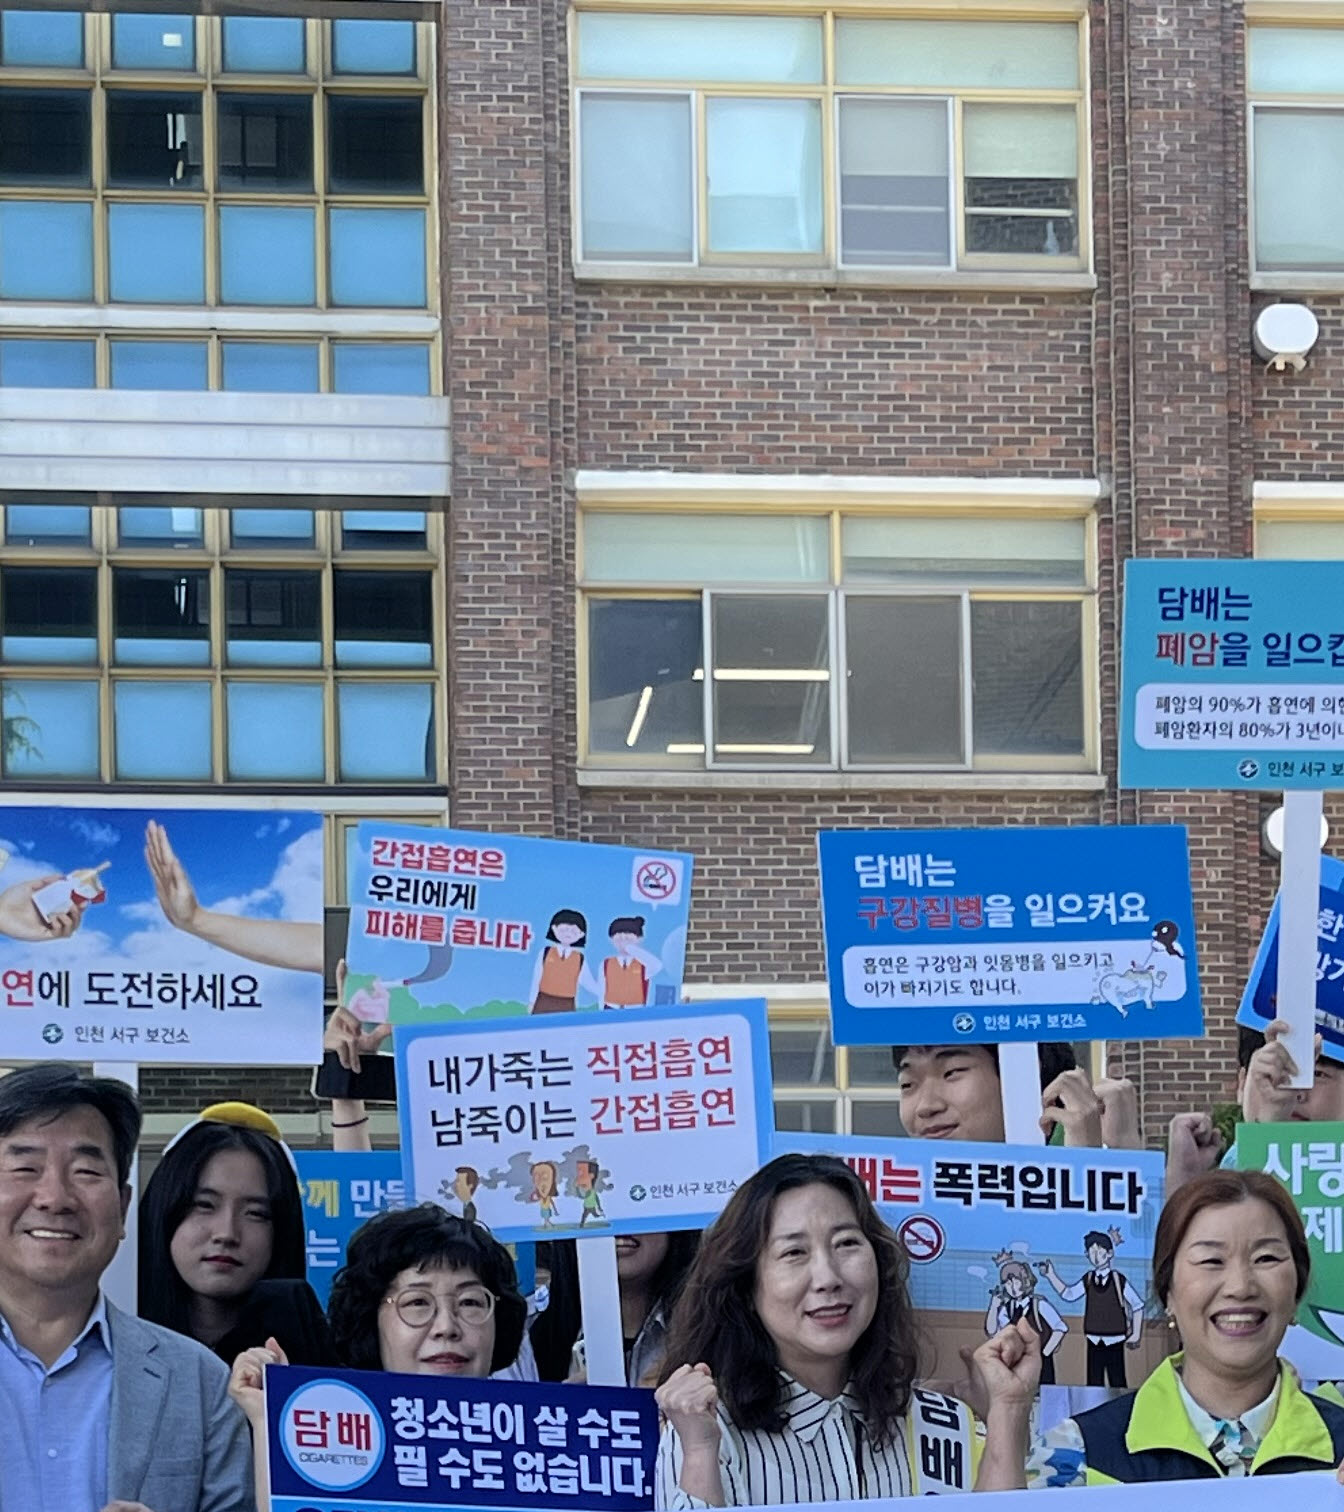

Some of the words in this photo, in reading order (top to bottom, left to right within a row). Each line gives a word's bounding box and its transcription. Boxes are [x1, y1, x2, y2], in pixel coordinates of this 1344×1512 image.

[1157, 586, 1253, 622] 담배는
[1156, 631, 1252, 668] 폐암을
[1208, 696, 1261, 714] 90%가
[1266, 696, 1316, 715] 흡연에
[1238, 722, 1292, 740] 80%가
[1268, 761, 1295, 777] 인천
[1300, 762, 1326, 777] 서구
[372, 839, 505, 878] 간접흡연은
[855, 854, 956, 889] 담배는
[368, 875, 477, 910] 우리에게
[857, 894, 1016, 930] 구강질병을
[1025, 892, 1150, 929] 일으켜요
[366, 910, 445, 943] 피해를
[451, 917, 532, 951] 줍니다
[862, 957, 908, 975] 흡연은
[915, 955, 977, 973] 구강암과
[983, 953, 1045, 972] 잇몸병을
[1052, 952, 1113, 970] 일으키고
[83, 973, 261, 1010] 도전하세요
[864, 980, 896, 998] 이가
[900, 979, 962, 998] 빠지기도
[970, 978, 1022, 996] 합니다.
[74, 1026, 104, 1044] 인천
[110, 1027, 140, 1044] 서구
[145, 1027, 190, 1044] 보건소
[983, 1014, 1011, 1031] 인천
[1015, 1014, 1042, 1030] 서구
[1047, 1013, 1086, 1030] 보건소
[428, 1050, 574, 1095] 내가죽는
[587, 1035, 733, 1082] 직접흡연
[430, 1101, 576, 1147] 남죽이는
[589, 1087, 736, 1135] 간접흡연
[650, 1184, 674, 1199] 인천
[677, 1182, 700, 1196] 서구
[703, 1180, 737, 1195] 보건소
[933, 1161, 1143, 1214] 폭력입니다
[294, 1408, 372, 1451] 담배
[391, 1396, 525, 1445] 청소년이
[533, 1406, 568, 1446] 살
[578, 1408, 643, 1449] 수도
[393, 1444, 429, 1488] 필
[438, 1448, 505, 1490] 수도
[514, 1450, 652, 1499] 없습니다.
